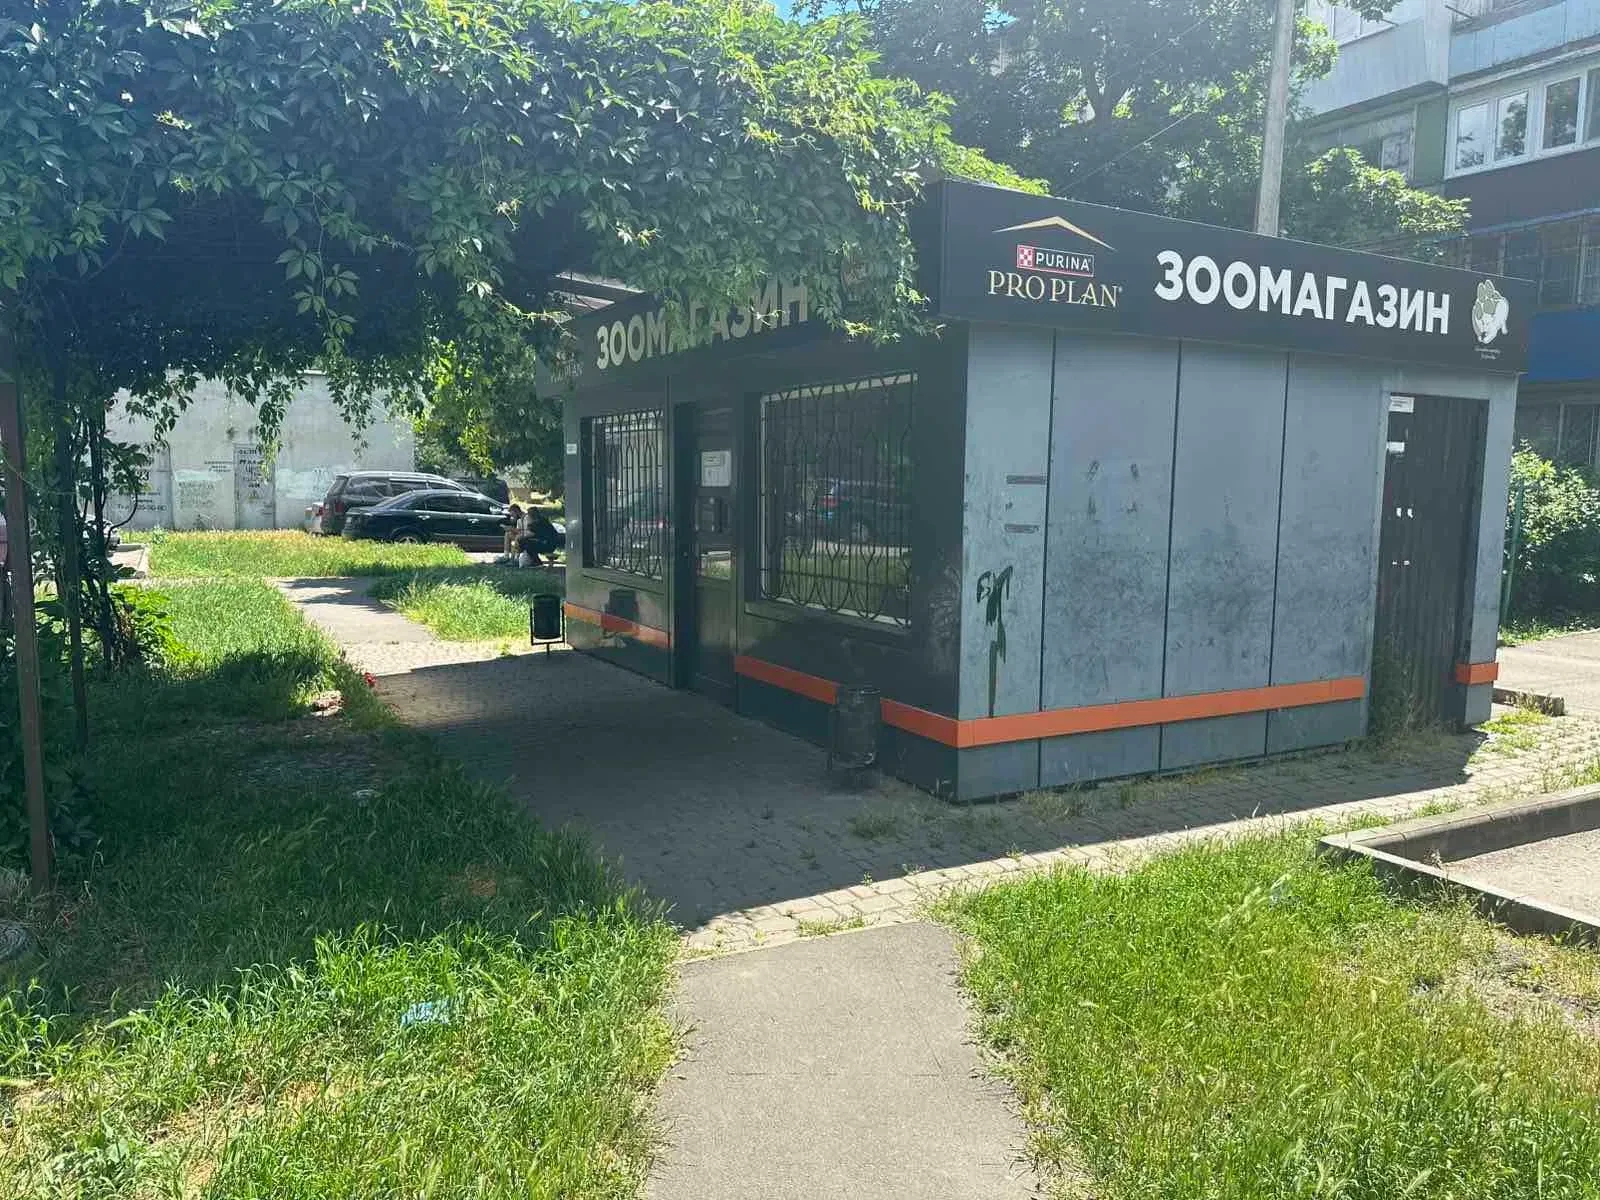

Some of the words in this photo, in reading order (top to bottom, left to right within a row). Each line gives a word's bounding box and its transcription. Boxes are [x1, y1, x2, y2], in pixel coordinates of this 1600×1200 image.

[1035, 252, 1090, 271] PURINA
[987, 270, 1045, 300] PRO
[1049, 278, 1118, 307] PLAN
[1154, 250, 1450, 335] ЗООМАГАЗИН
